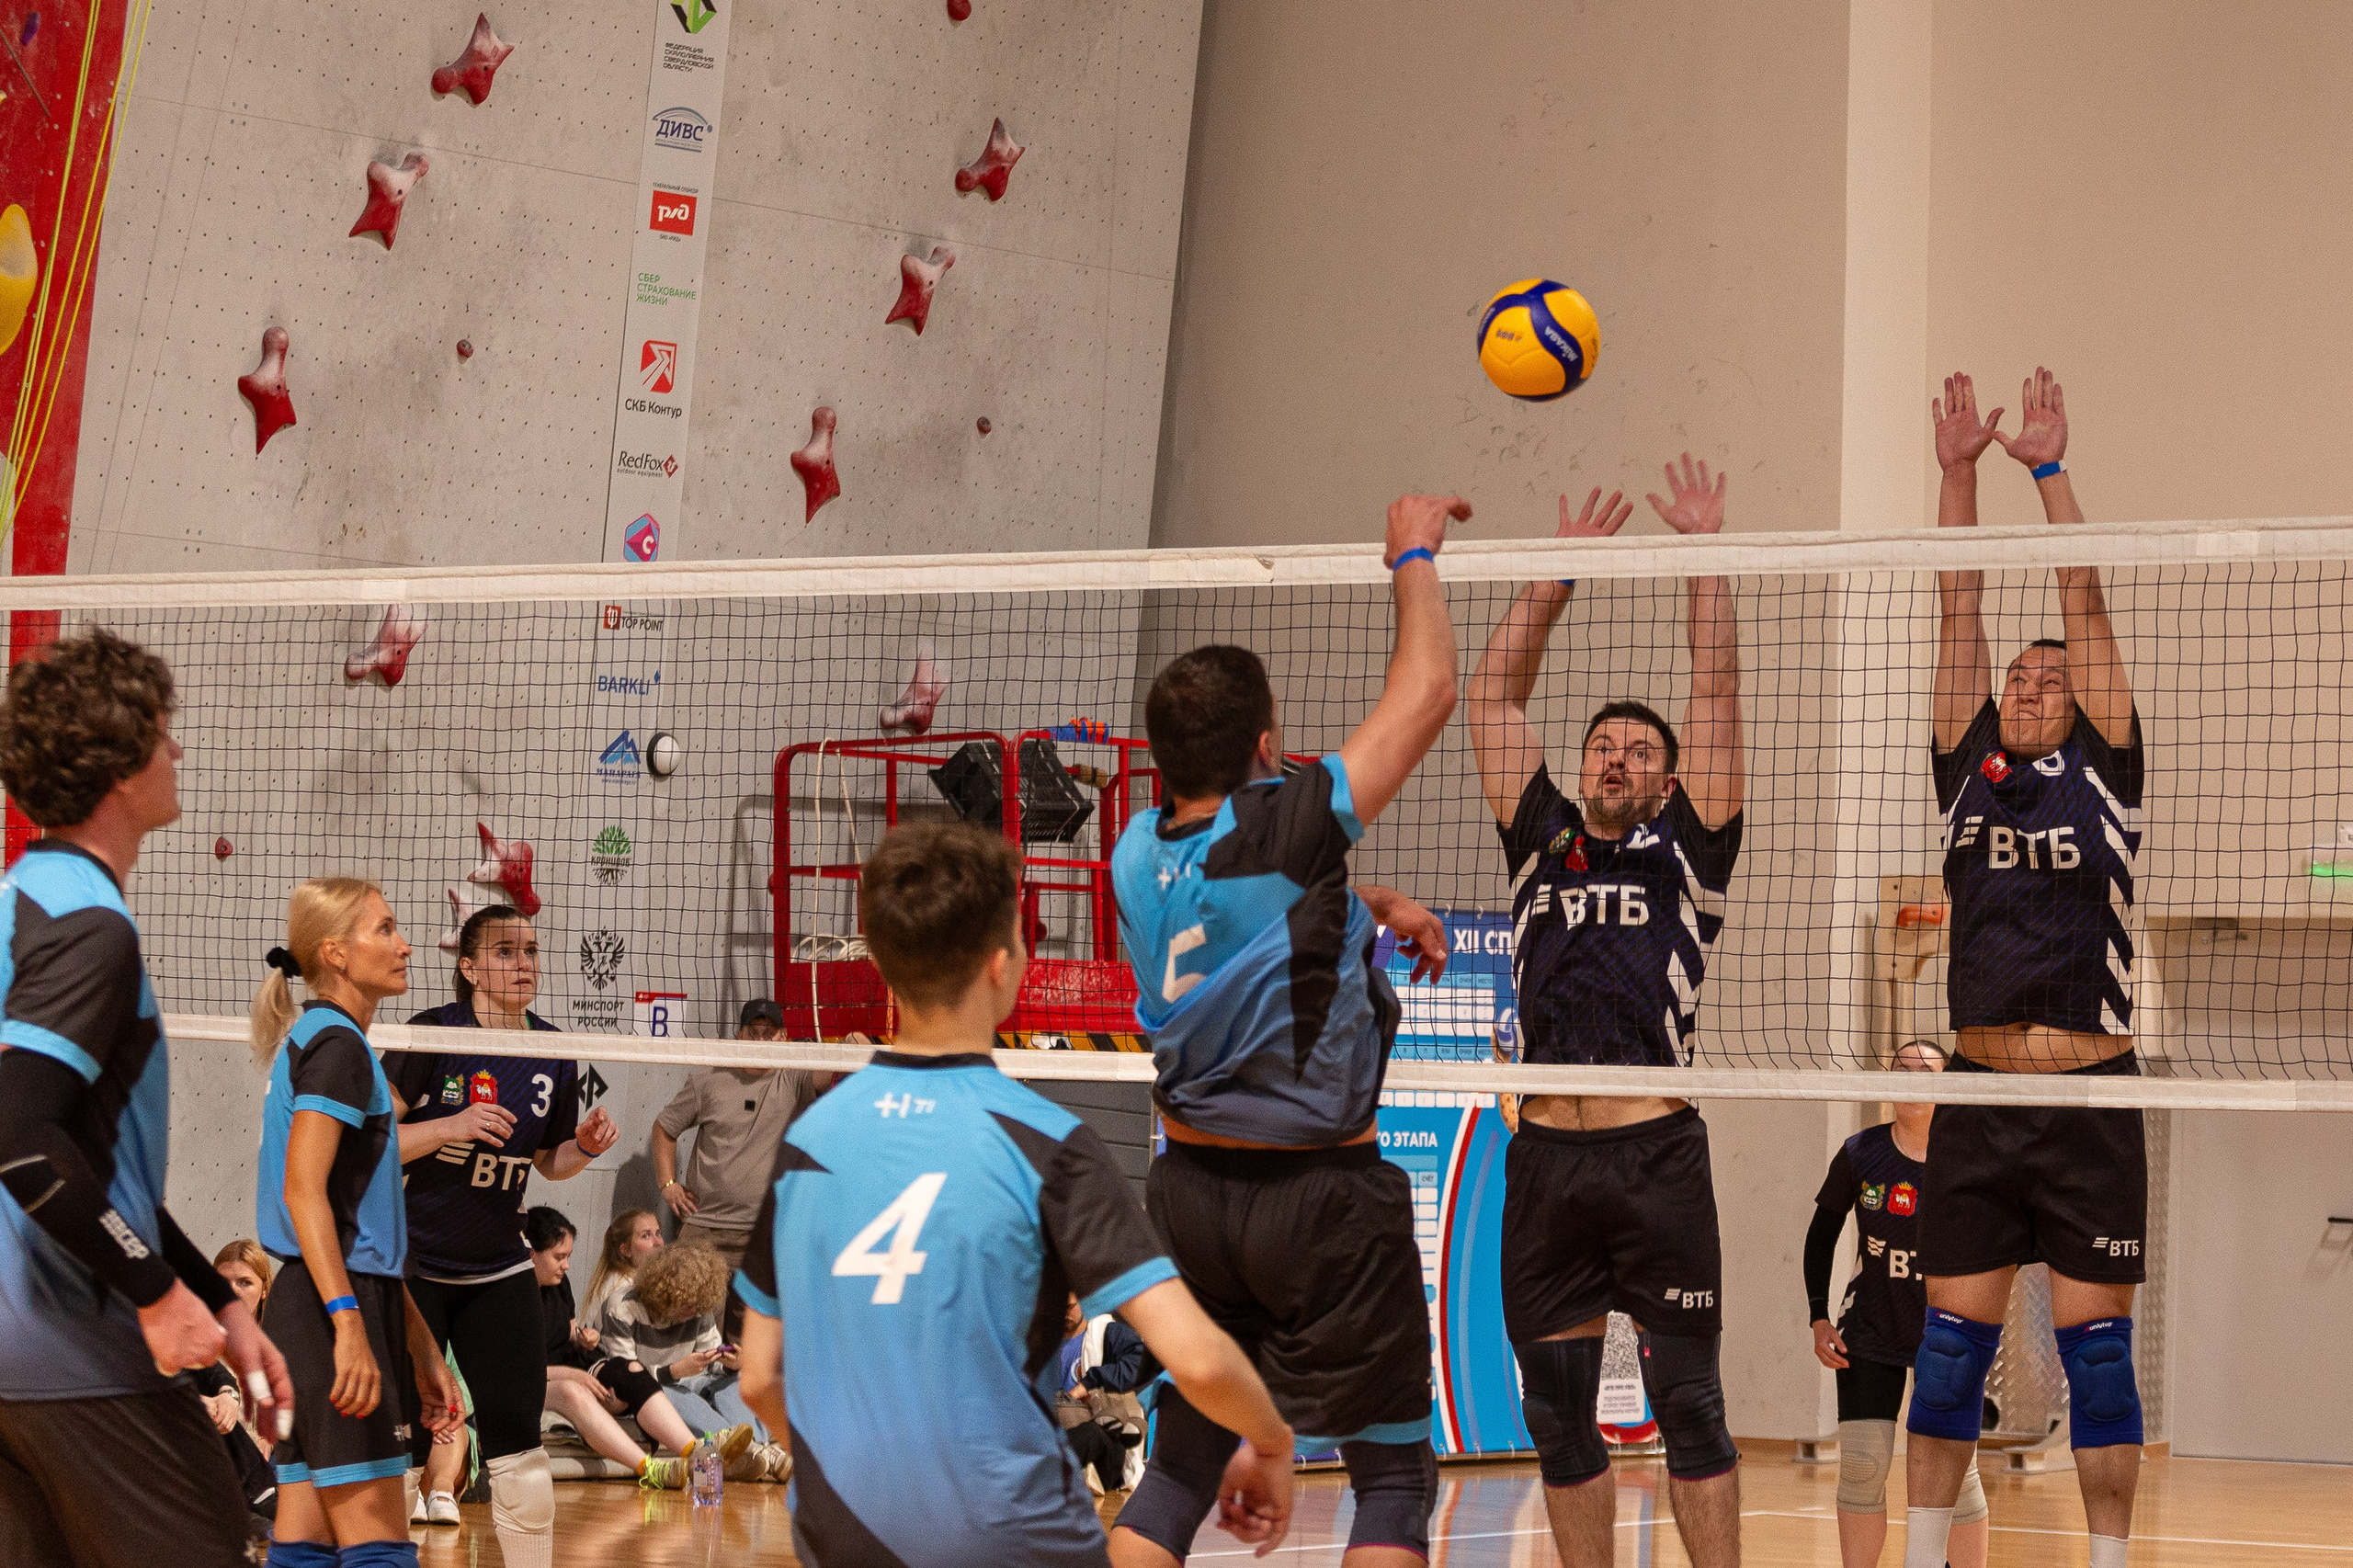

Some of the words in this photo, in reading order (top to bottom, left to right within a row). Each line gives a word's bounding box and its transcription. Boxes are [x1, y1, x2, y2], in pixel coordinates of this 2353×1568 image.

[656, 119, 704, 142] ДИВС
[638, 272, 660, 283] СБЕР
[636, 293, 668, 305] ЖИЗНИ
[637, 283, 697, 300] СТРАХОВАНИЕ
[625, 398, 646, 413] СКБ
[648, 401, 682, 418] Контур
[621, 618, 638, 630] TOP
[640, 619, 663, 631] POINT
[597, 676, 650, 696] BARKLI
[1989, 826, 2081, 869] ВТБ
[1559, 884, 1649, 930] ВТБ
[573, 1000, 624, 1011] МИНСПОРТ
[577, 1017, 617, 1028] РОССИИ
[531, 1074, 553, 1118] 3
[1393, 1131, 1438, 1148] ЭТАПА
[831, 1172, 948, 1305] 4
[2109, 1240, 2140, 1257] ВТБ
[1682, 1290, 1714, 1309] ВТБ
